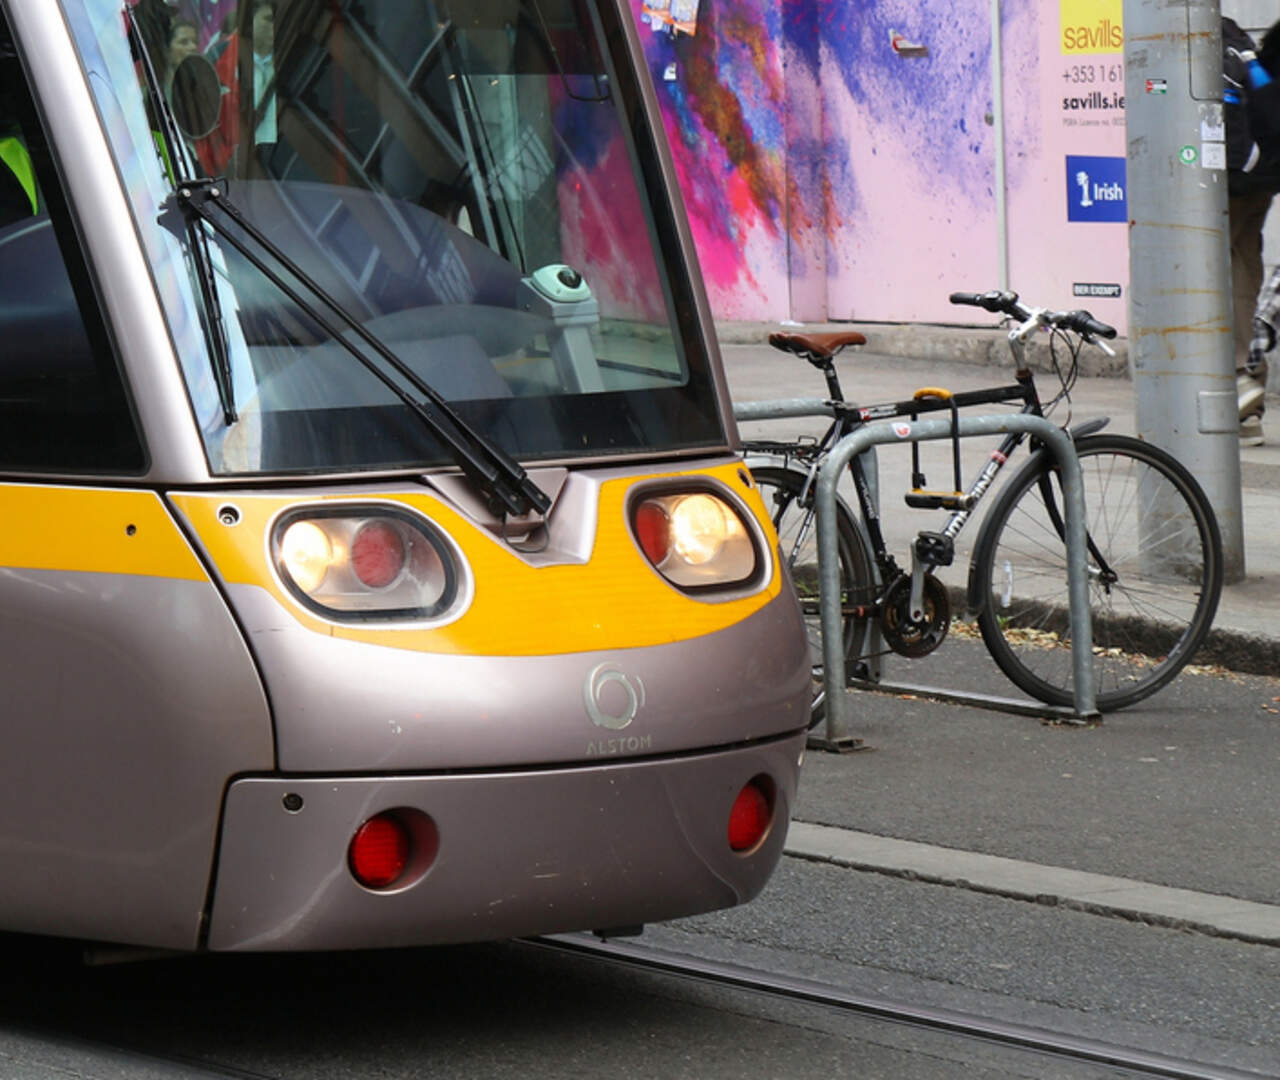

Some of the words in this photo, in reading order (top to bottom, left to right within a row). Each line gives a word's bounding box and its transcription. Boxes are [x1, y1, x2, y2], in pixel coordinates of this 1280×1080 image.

[1063, 19, 1123, 49] savills
[1062, 65, 1095, 83] +353
[1063, 92, 1125, 110] savills.ie
[1093, 182, 1124, 201] Irish
[585, 734, 652, 756] ALSTOM
